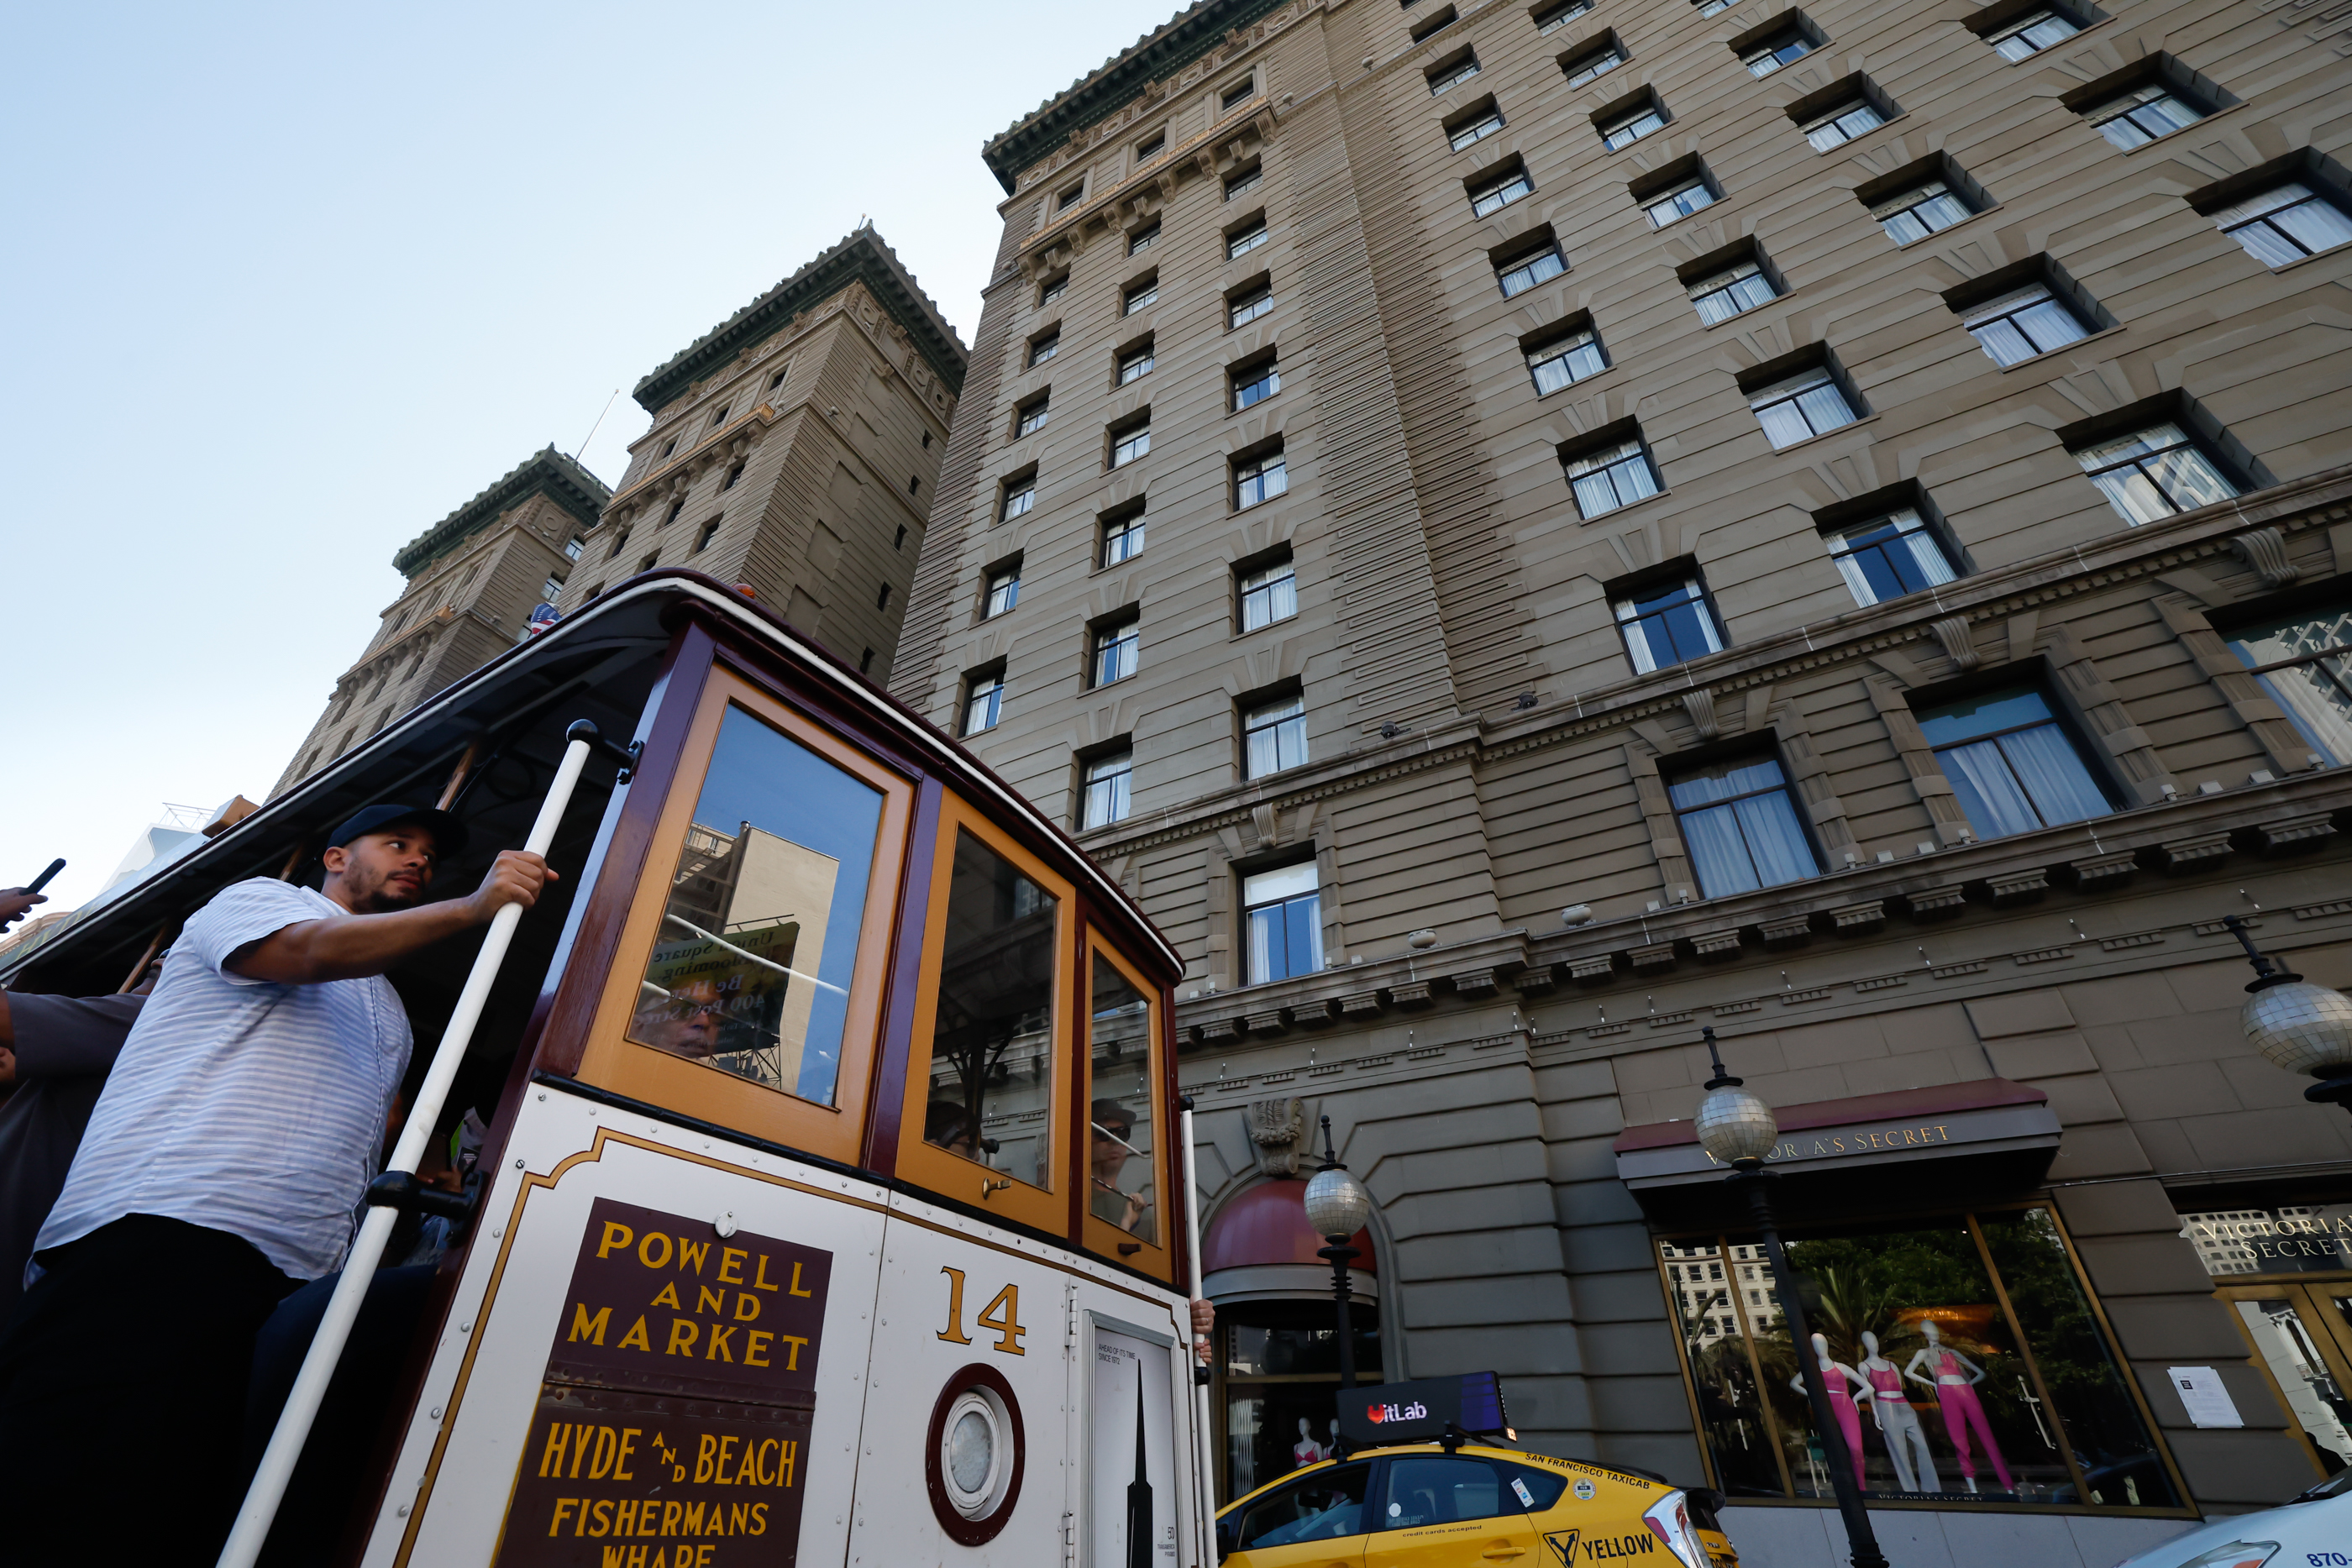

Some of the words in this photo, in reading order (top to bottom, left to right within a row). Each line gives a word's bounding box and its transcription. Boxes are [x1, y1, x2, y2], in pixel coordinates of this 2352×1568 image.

[1705, 1137, 1845, 1166] VORIA'S
[1854, 1125, 1949, 1150] SECRET
[596, 1220, 811, 1298] POWELL
[2240, 1238, 2352, 1260] SECRET
[650, 1281, 761, 1322] AND
[936, 1266, 1026, 1356] 14
[567, 1303, 808, 1371] MARKET
[1098, 1343, 1113, 1354] AHEAD
[1126, 1350, 1136, 1360] TIME
[1098, 1352, 1111, 1362] SINCE
[538, 1422, 642, 1481] HYDE
[652, 1431, 685, 1483] AND
[693, 1434, 797, 1487] BEACH
[1525, 1453, 1546, 1464] SAN
[1547, 1458, 1604, 1477] FRANCISCO
[1606, 1471, 1651, 1490] TAXICAB
[549, 1498, 769, 1538] FISHERMANS
[1582, 1533, 1654, 1560] YELLOW
